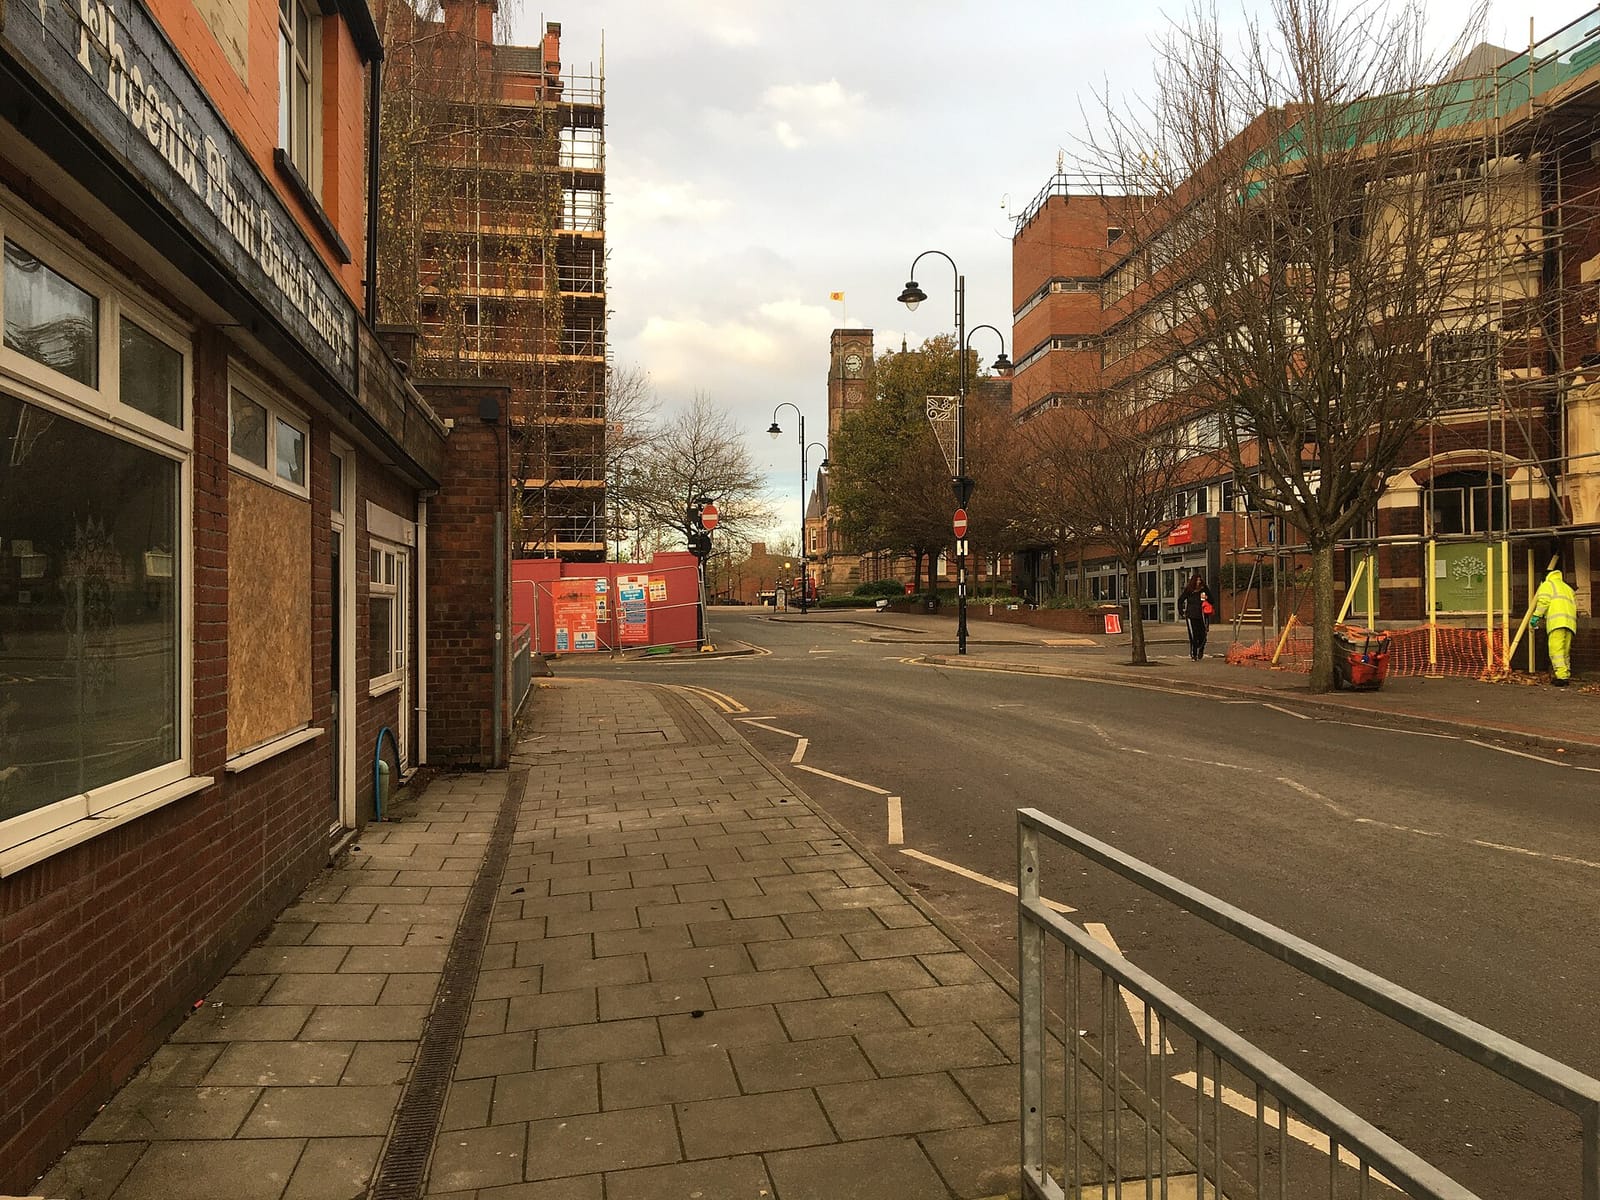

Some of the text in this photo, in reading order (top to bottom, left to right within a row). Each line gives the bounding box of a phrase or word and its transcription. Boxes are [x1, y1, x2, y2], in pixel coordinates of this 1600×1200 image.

[77, 0, 342, 365] Phoenix Plant Based Eatery
